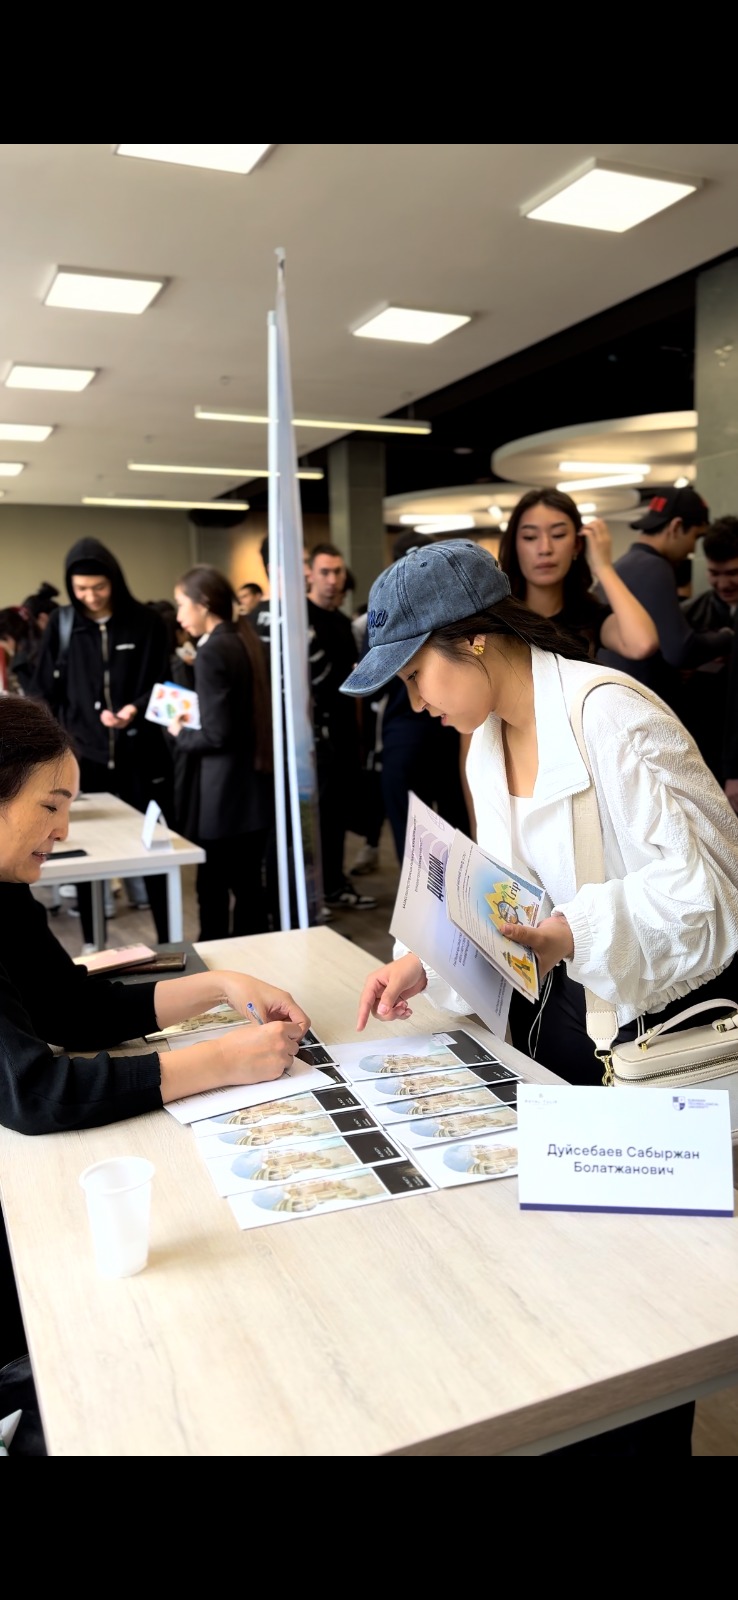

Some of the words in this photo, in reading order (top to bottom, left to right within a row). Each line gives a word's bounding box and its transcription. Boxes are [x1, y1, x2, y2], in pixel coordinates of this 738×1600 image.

[427, 853, 445, 902] ДИПЛОМ
[547, 1143, 623, 1158] Дуйсебаев
[626, 1146, 700, 1161] Сабыржан
[573, 1161, 674, 1175] Болатжанович
